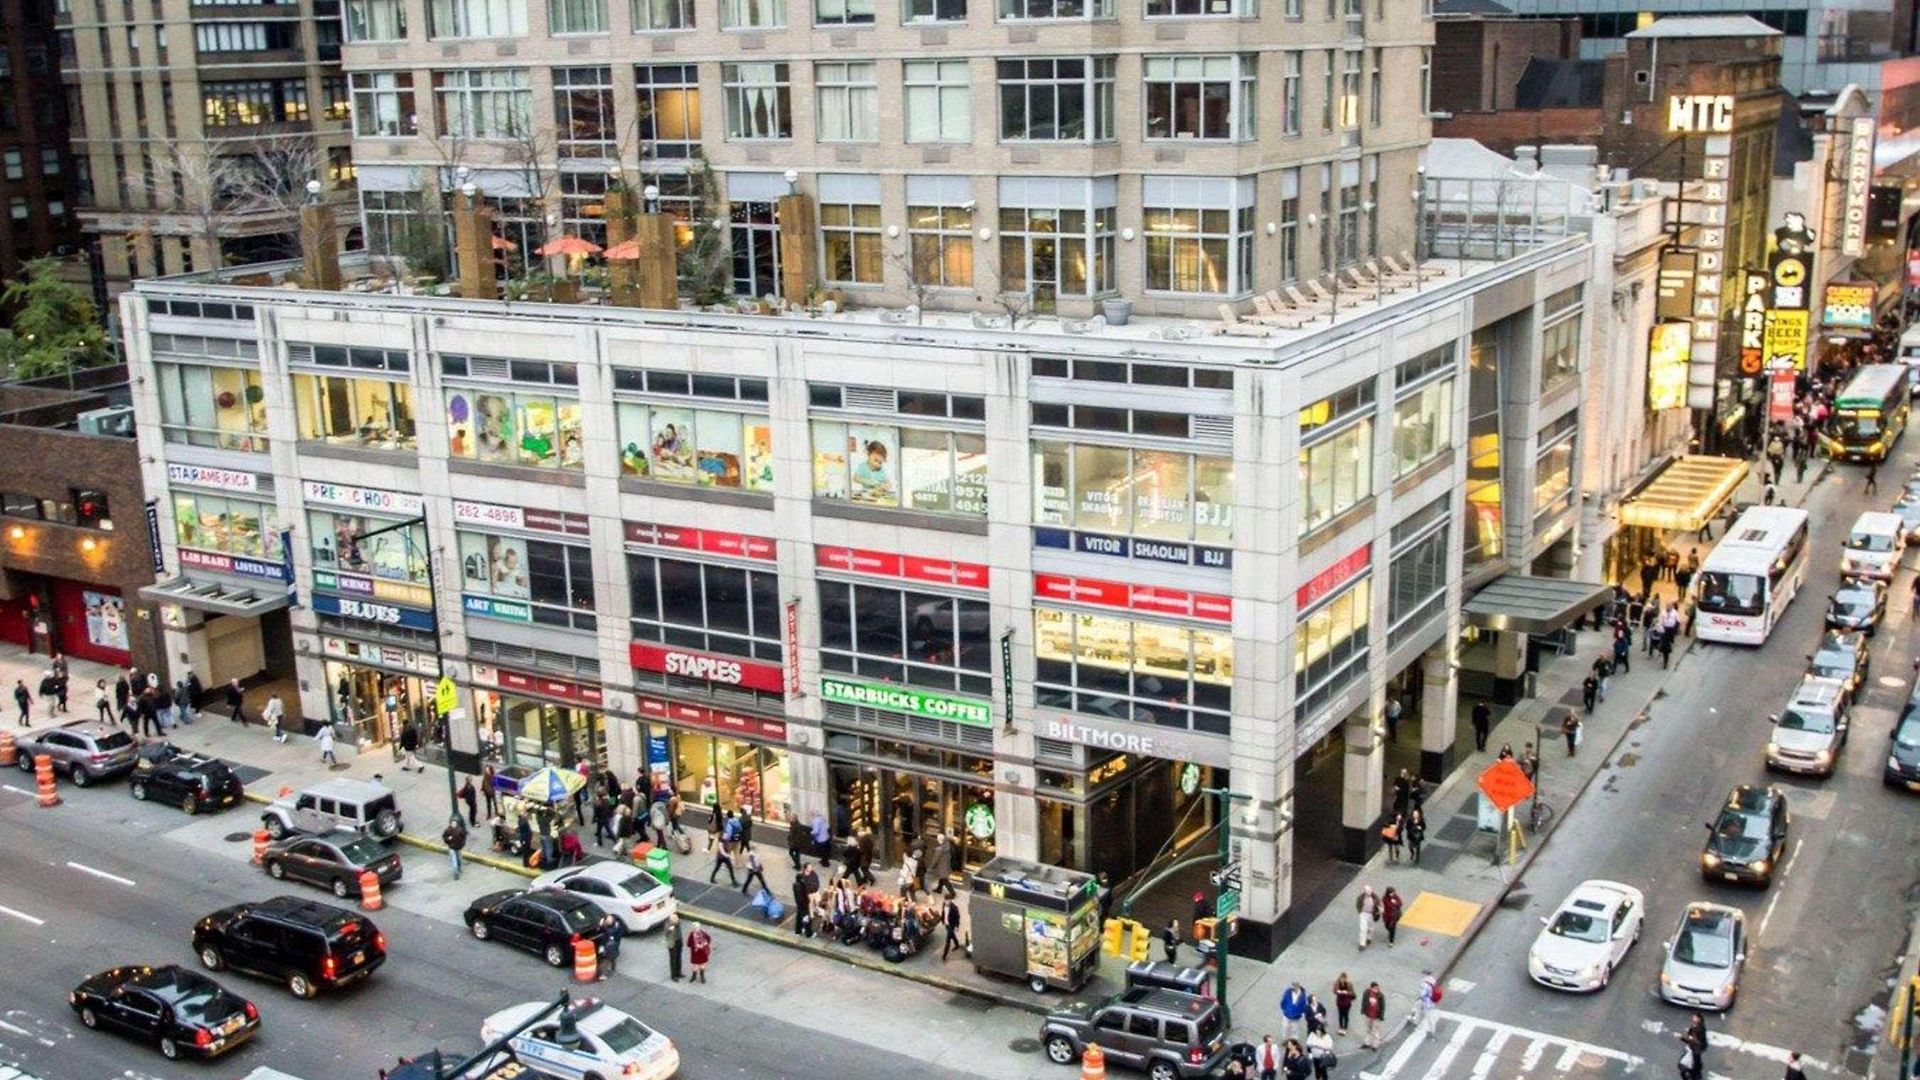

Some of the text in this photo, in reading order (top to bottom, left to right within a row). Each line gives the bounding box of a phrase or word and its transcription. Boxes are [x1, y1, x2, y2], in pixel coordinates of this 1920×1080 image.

[1669, 95, 1734, 131] MTC
[1847, 122, 1869, 253] BARRYMORE
[1743, 275, 1765, 348] PARK
[1195, 501, 1233, 527] BJJ
[1085, 536, 1225, 565] VITOR SHAOLIN BJJ
[338, 598, 401, 624] BLUES
[466, 598, 490, 611] ART
[665, 651, 742, 684] STAPLES
[824, 681, 988, 722] STARBUCKS COFFEE
[1048, 721, 1154, 753] BILTMORE
